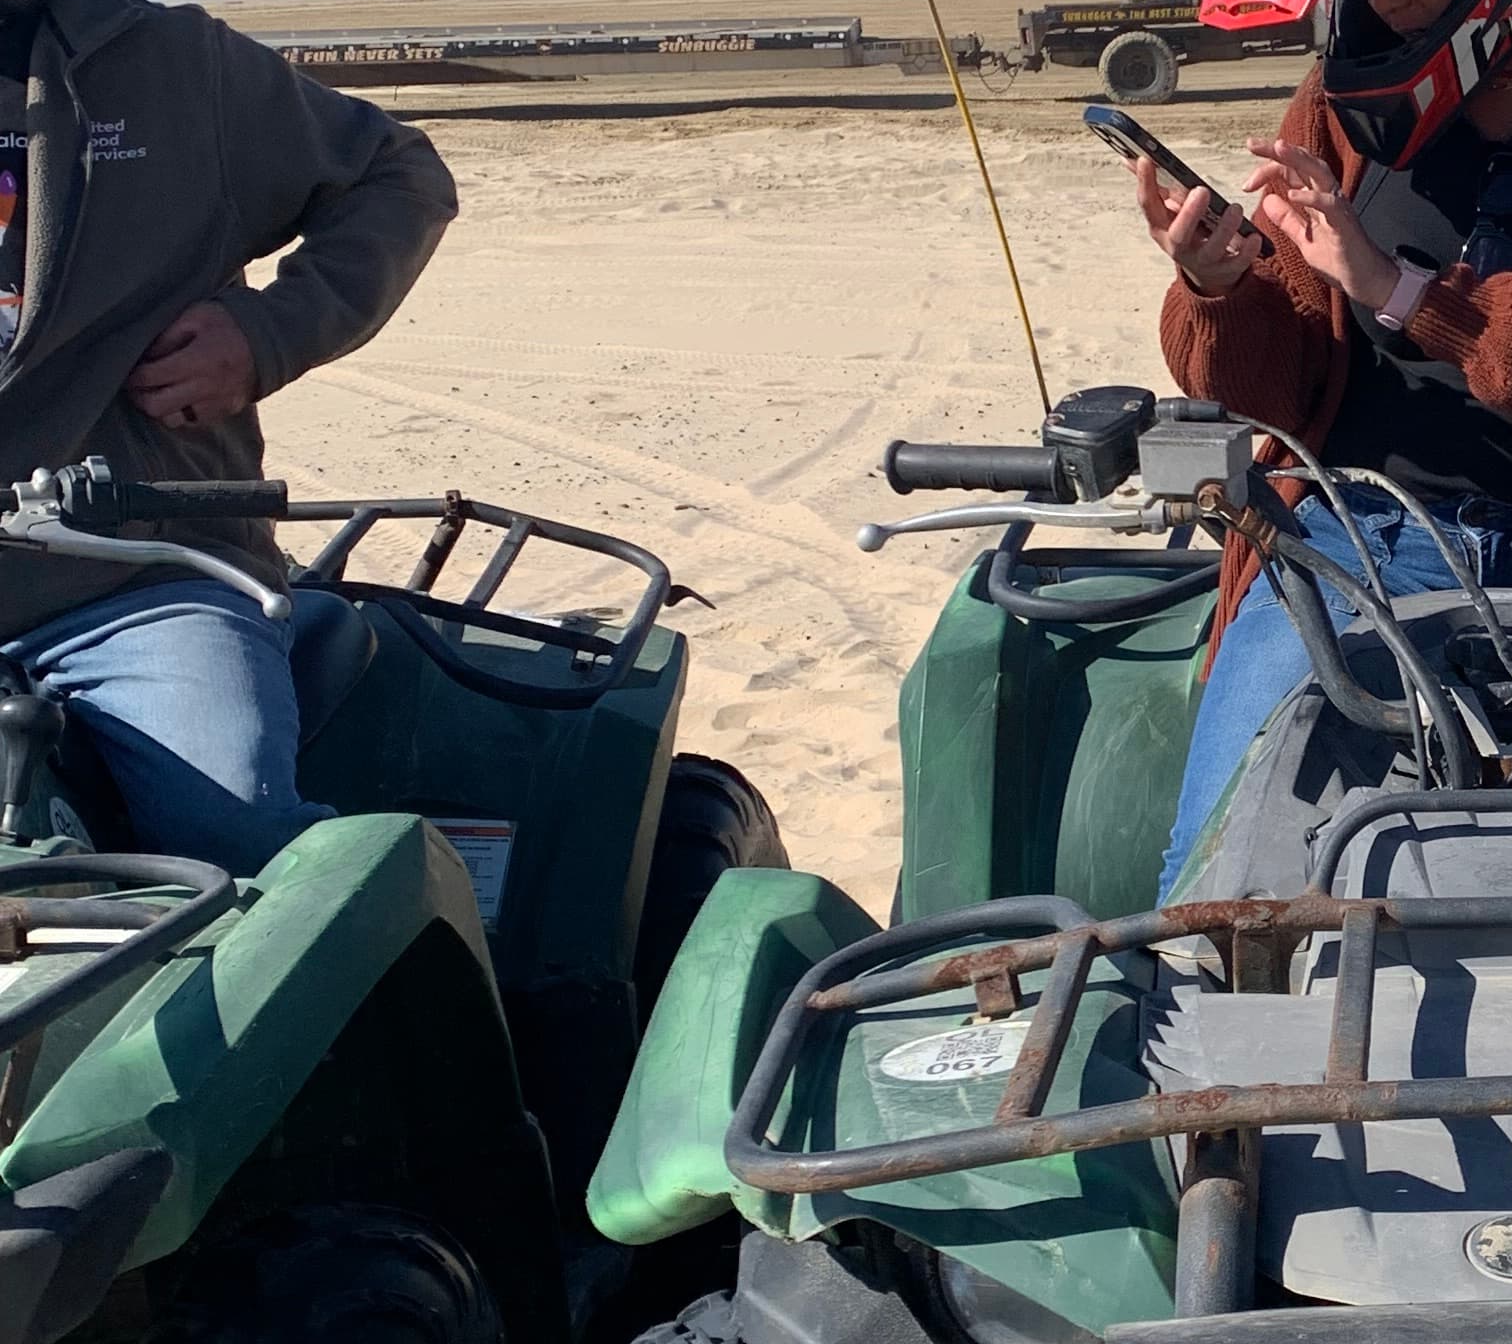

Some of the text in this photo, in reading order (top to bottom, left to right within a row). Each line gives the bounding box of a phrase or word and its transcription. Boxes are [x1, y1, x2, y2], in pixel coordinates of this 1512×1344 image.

[658, 39, 755, 53] SUNBUGGIE
[303, 50, 338, 63] FUN
[344, 48, 399, 62] NEVER
[405, 47, 444, 60] SETS
[926, 1055, 1003, 1075] 067
